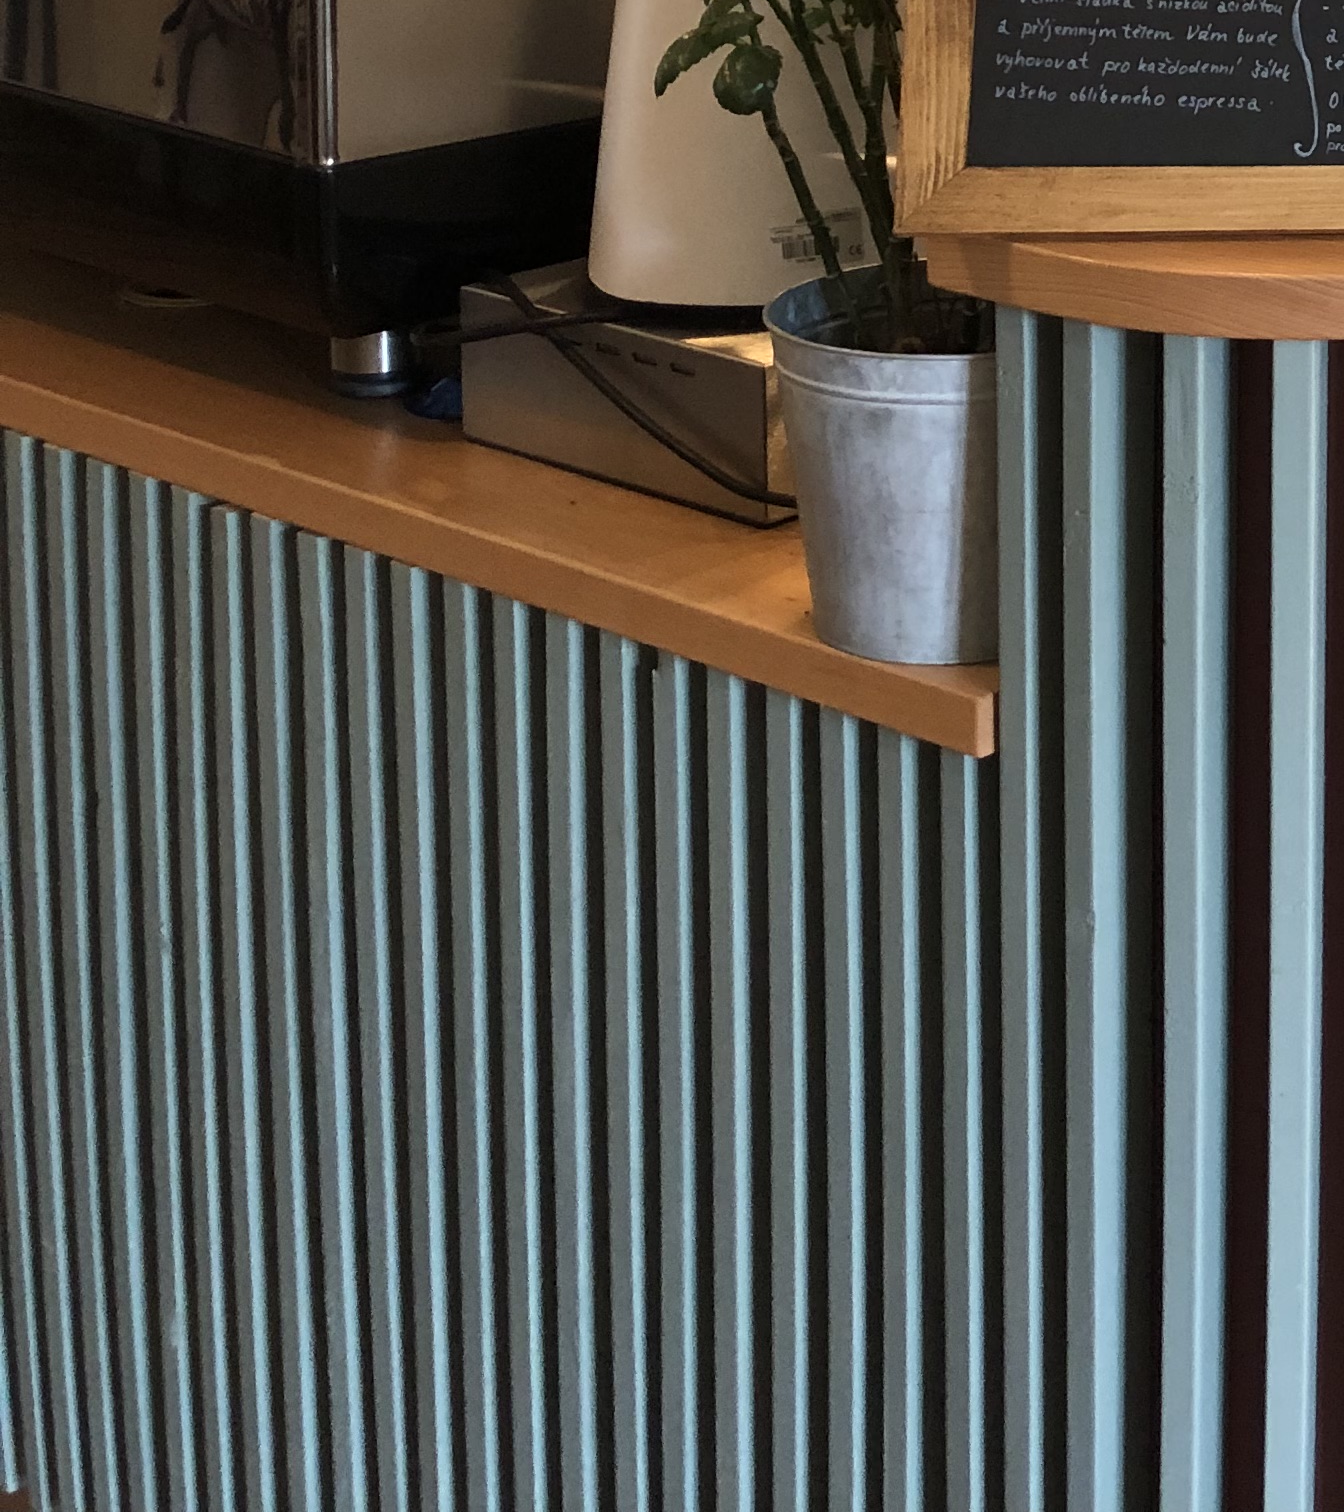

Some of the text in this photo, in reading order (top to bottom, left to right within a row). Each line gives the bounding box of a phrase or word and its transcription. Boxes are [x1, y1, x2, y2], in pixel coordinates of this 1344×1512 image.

[997, 17, 1279, 46] a příjemným tělem Vám bude
[1326, 28, 1337, 43] a
[996, 51, 1291, 82] vyhovovat pro každodenní šálek
[995, 82, 1057, 102] vašeho
[1070, 85, 1166, 106] oblíbeného
